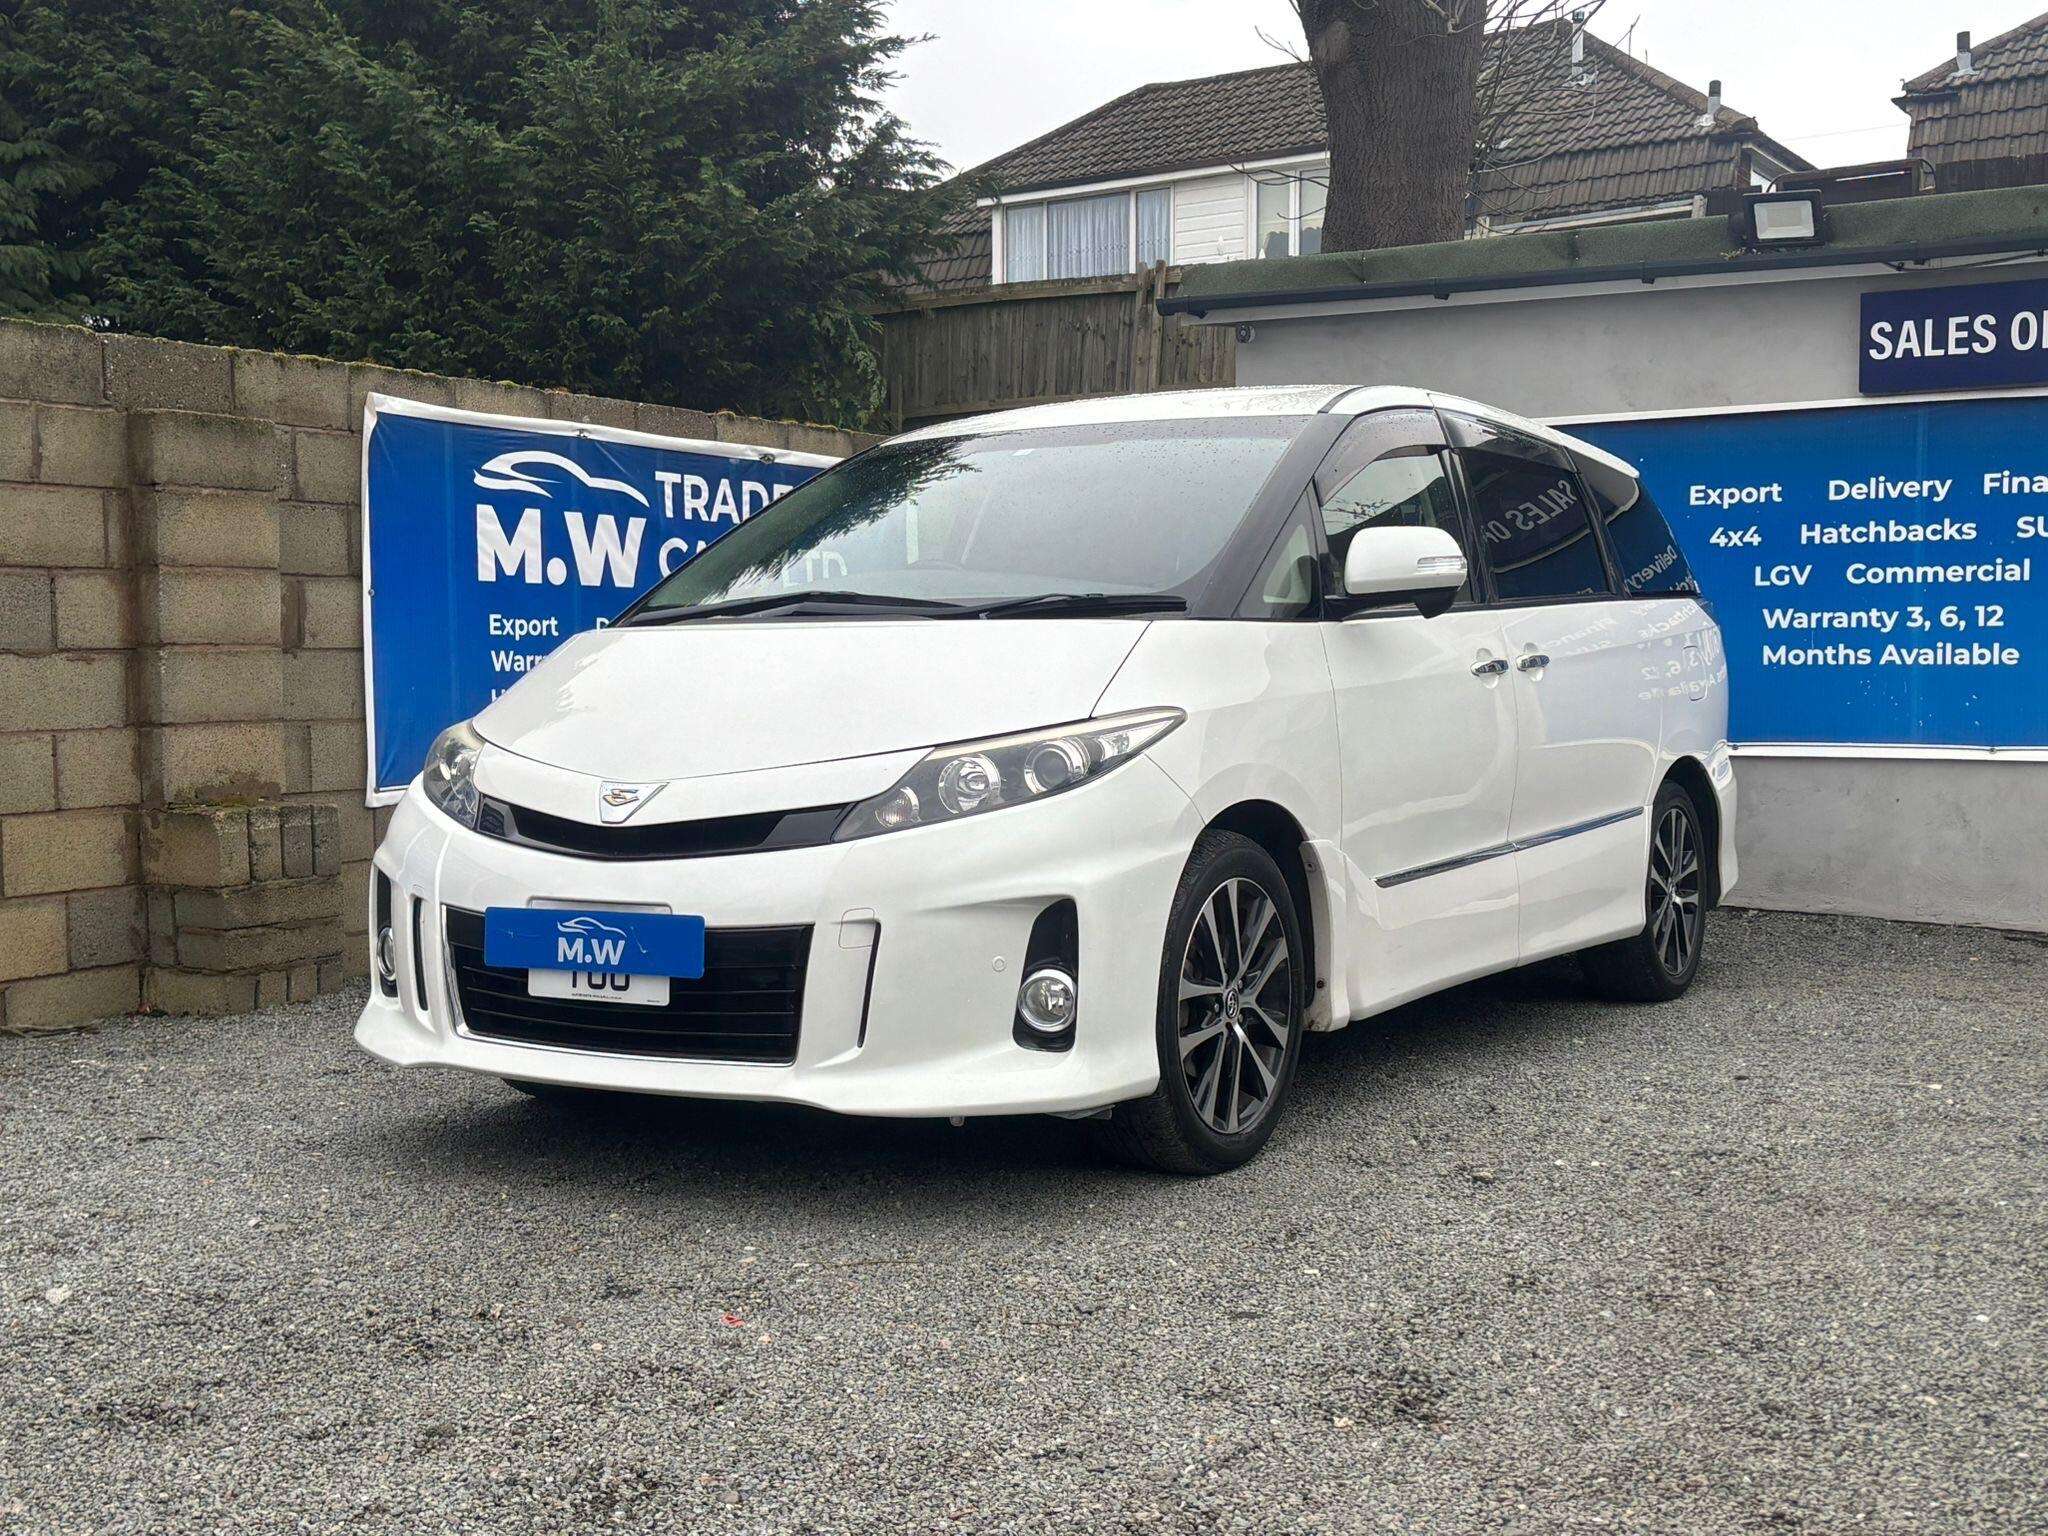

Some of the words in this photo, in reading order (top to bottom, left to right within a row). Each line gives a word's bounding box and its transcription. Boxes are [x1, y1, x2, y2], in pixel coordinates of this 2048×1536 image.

[1869, 313, 1997, 360] SALES
[1689, 482, 1783, 509] Export
[1828, 475, 1952, 502] Delivery
[476, 503, 647, 588] M.W
[1709, 526, 1762, 548] 4x4
[1800, 517, 1978, 545] Hatchbacks
[1754, 563, 1813, 588] LGV
[1846, 557, 2031, 585] Commercial
[488, 613, 559, 641] Export
[1762, 606, 1900, 633] Warranty
[1906, 606, 1931, 631] 3,
[1939, 605, 1966, 631] 6,
[1975, 605, 2004, 627] 12
[1762, 642, 1872, 666] Months
[1878, 641, 2020, 666] Available
[557, 936, 625, 966] M.W
